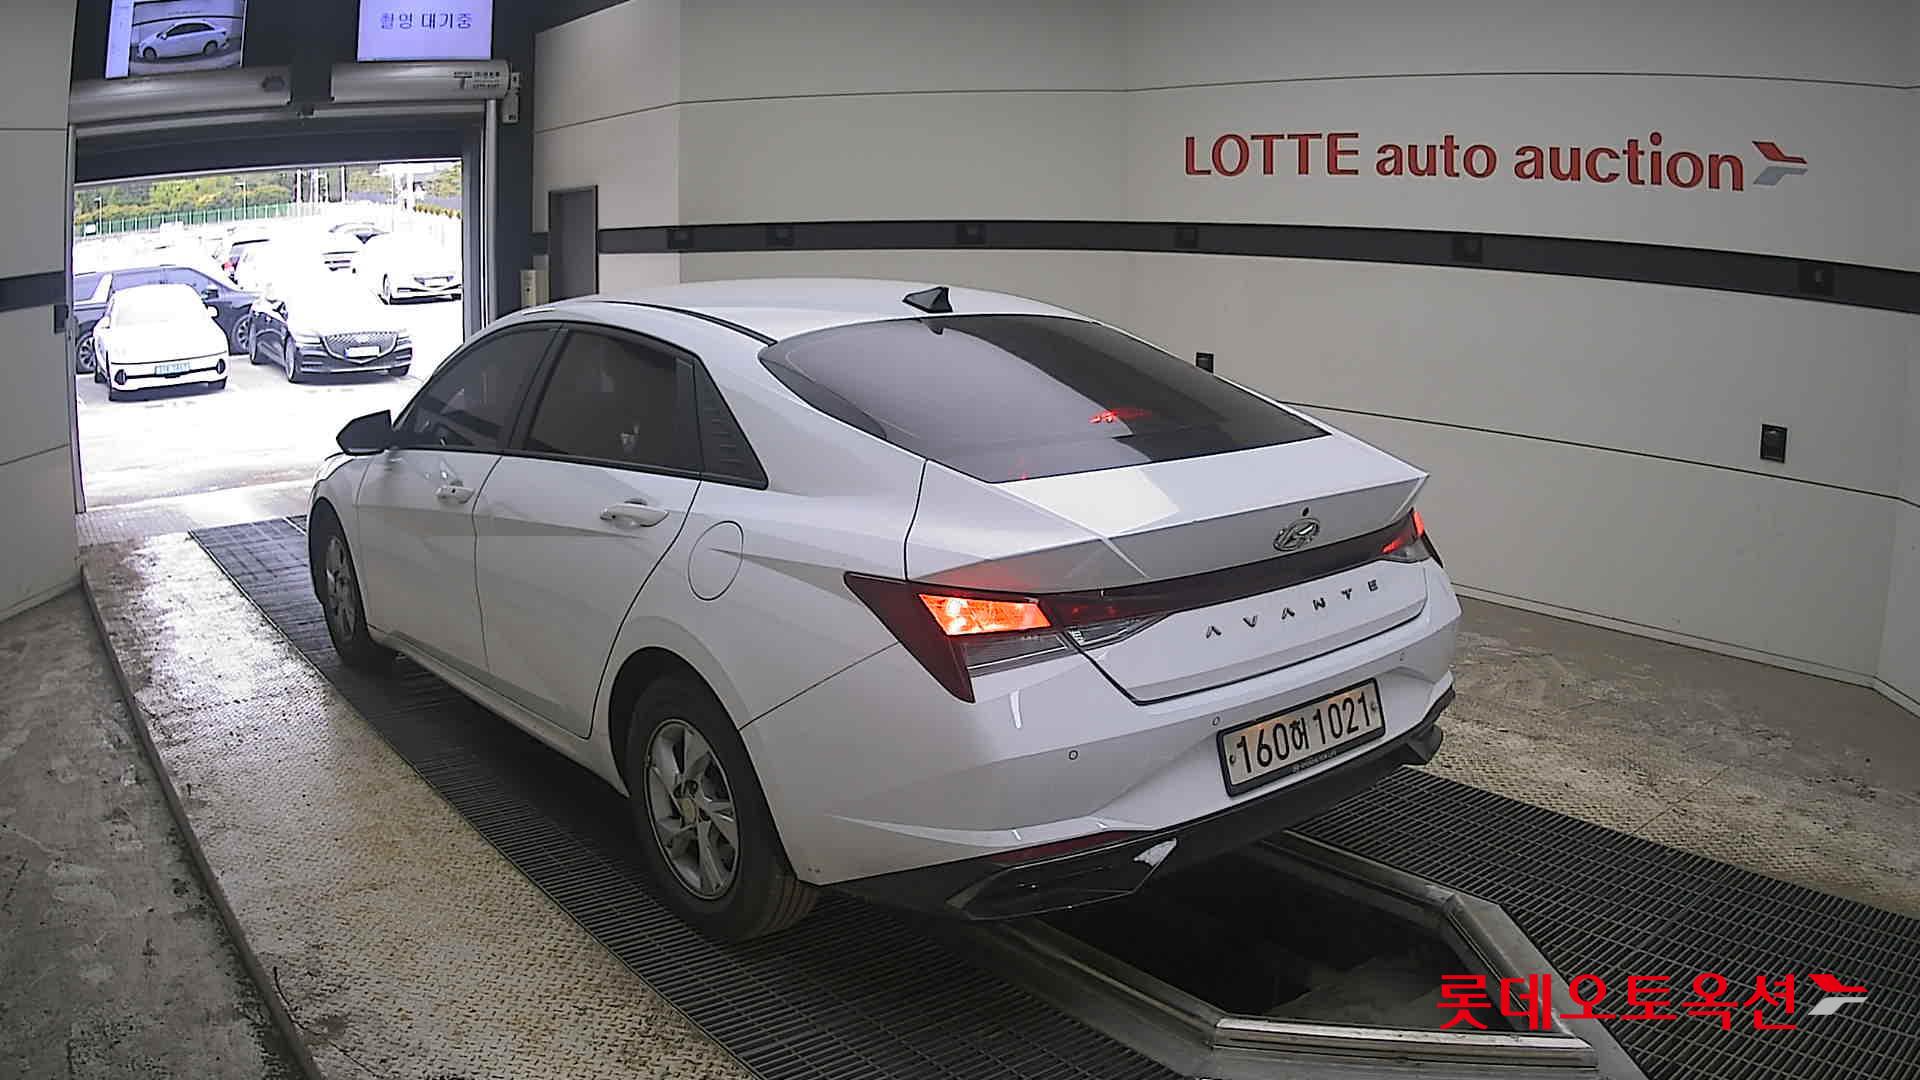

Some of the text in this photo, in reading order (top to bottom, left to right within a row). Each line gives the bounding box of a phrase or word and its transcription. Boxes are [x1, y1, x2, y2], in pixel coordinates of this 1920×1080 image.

[421, 12, 472, 30] 대기중
[1185, 131, 1745, 192] LOTTE auto auction
[1205, 579, 1379, 640] AVANTE
[1236, 716, 1310, 774] 160허
[1312, 691, 1371, 746] 1021
